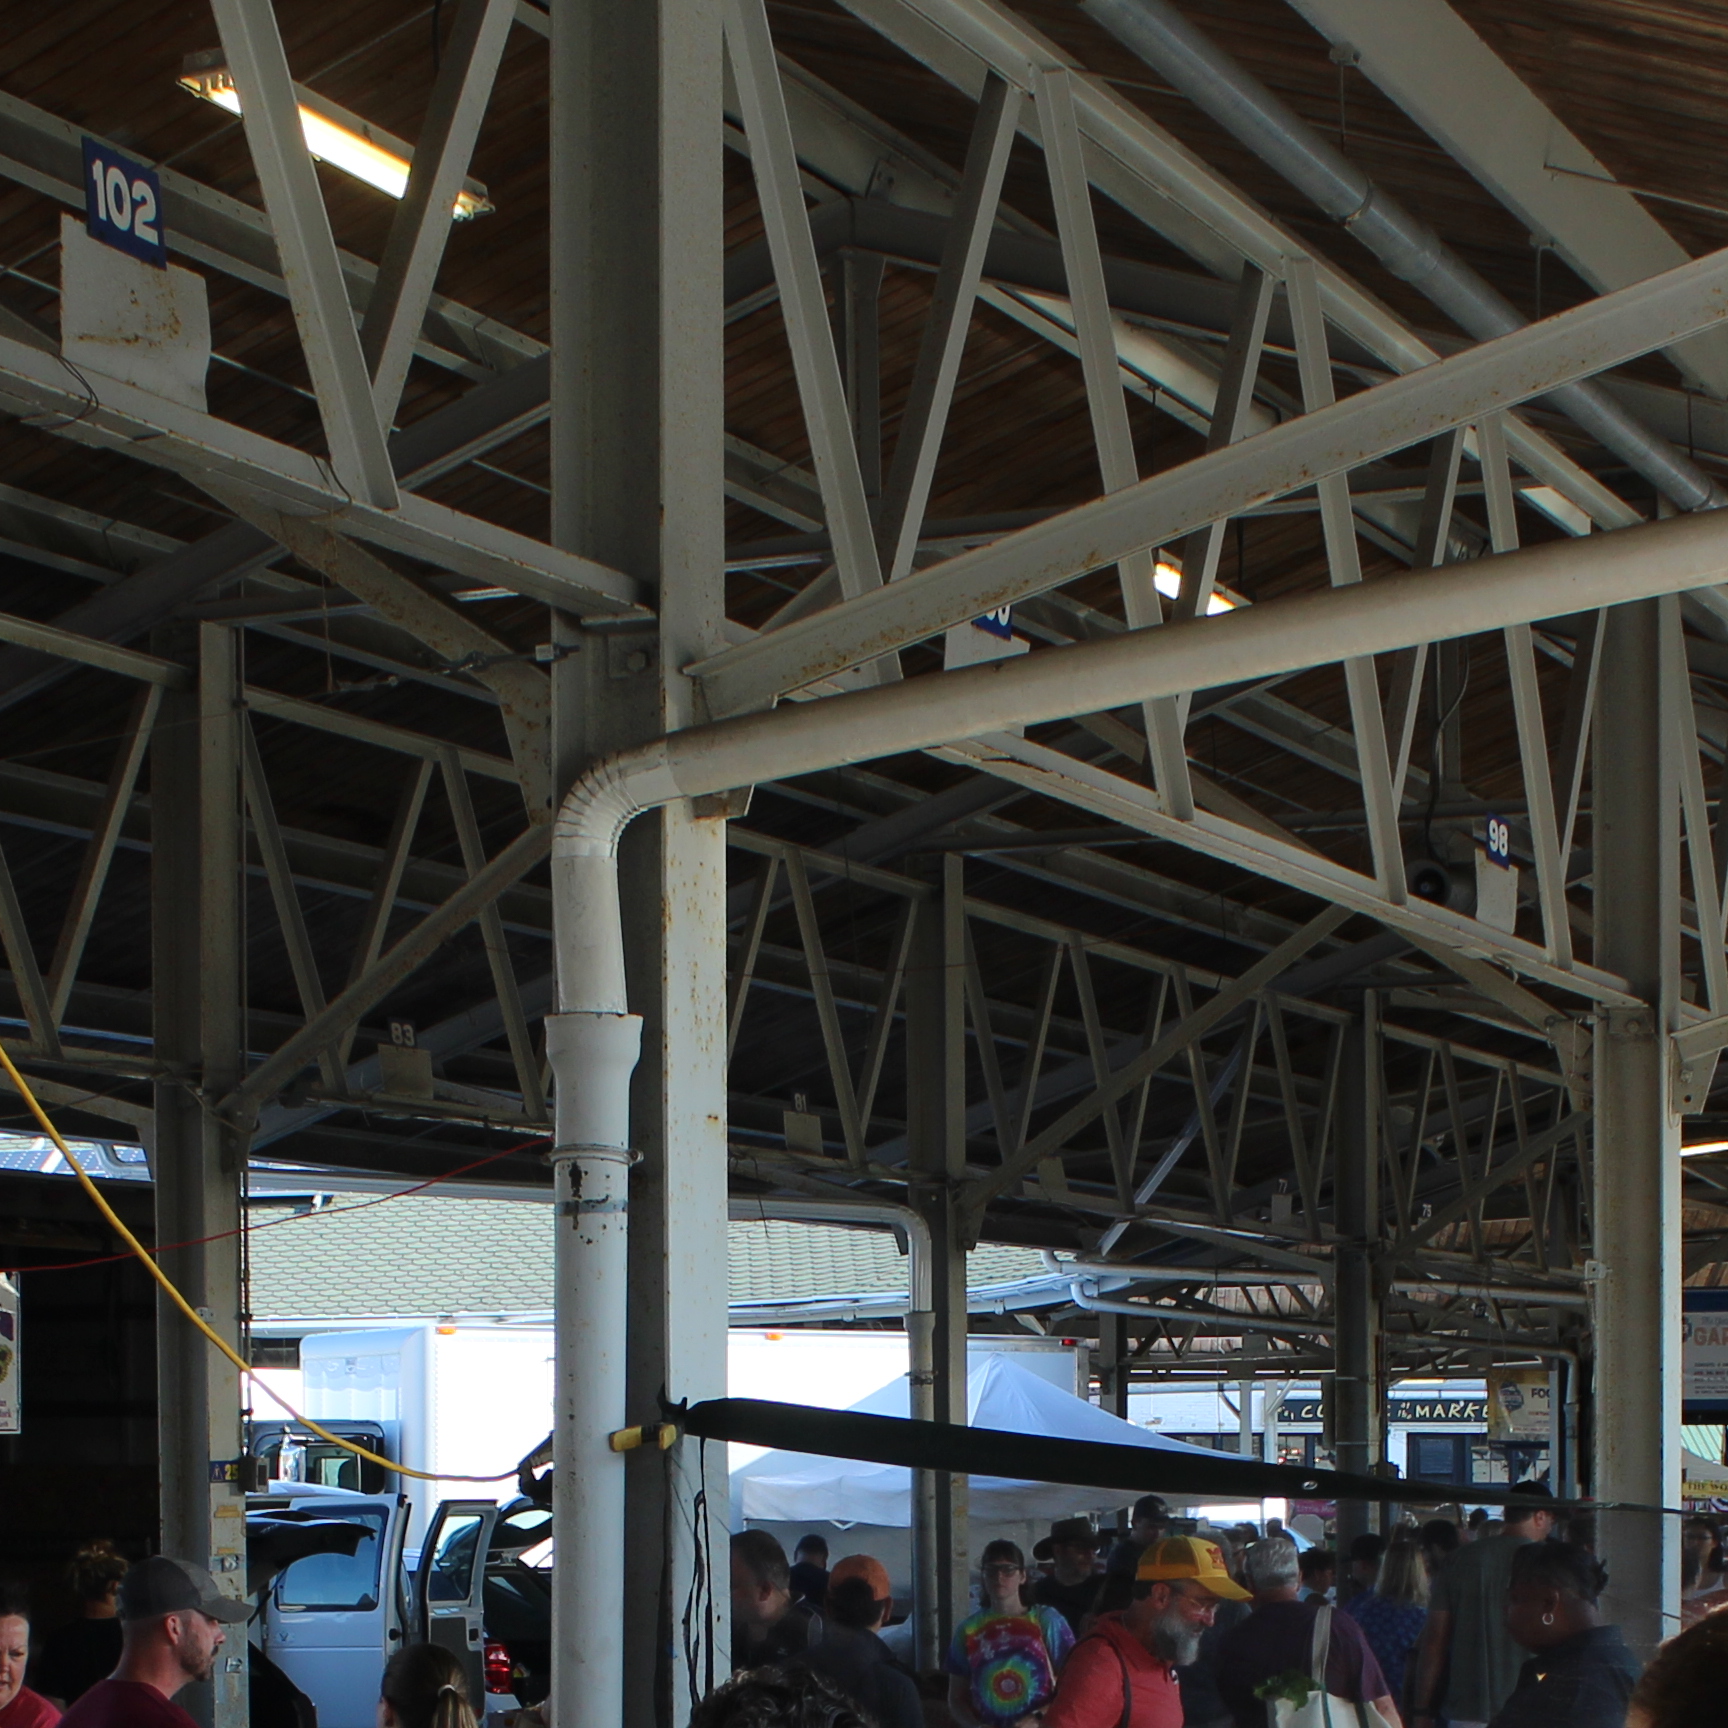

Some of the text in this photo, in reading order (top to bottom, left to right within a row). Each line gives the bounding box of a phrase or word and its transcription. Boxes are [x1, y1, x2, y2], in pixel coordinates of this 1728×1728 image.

[92, 158, 159, 243] 102
[1488, 818, 1508, 857] 98
[390, 1021, 416, 1047] 83
[794, 1092, 807, 1112] 81
